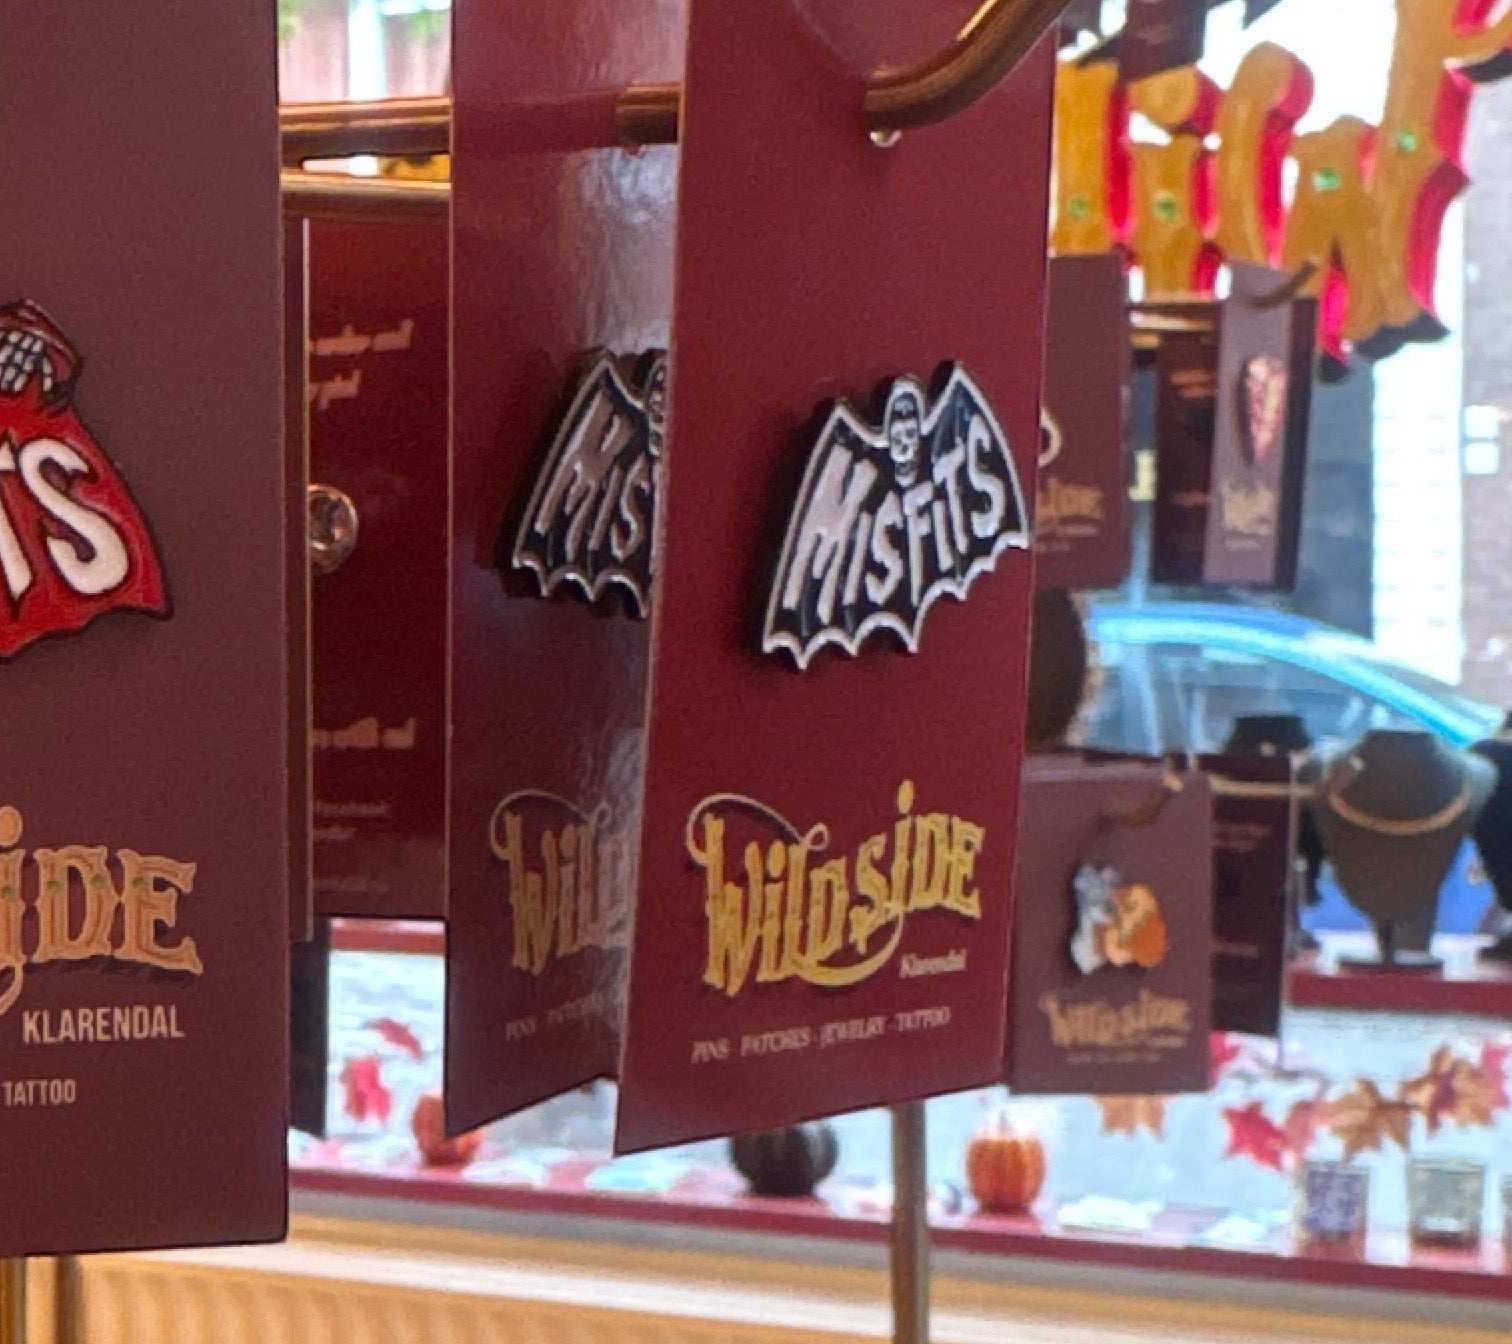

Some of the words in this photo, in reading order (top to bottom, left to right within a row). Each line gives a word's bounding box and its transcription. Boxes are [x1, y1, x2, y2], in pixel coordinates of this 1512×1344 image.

[782, 412, 1007, 626] MISFITS
[22, 1004, 186, 1046] KLARENDAL
[3, 1078, 77, 1107] TATTOO
